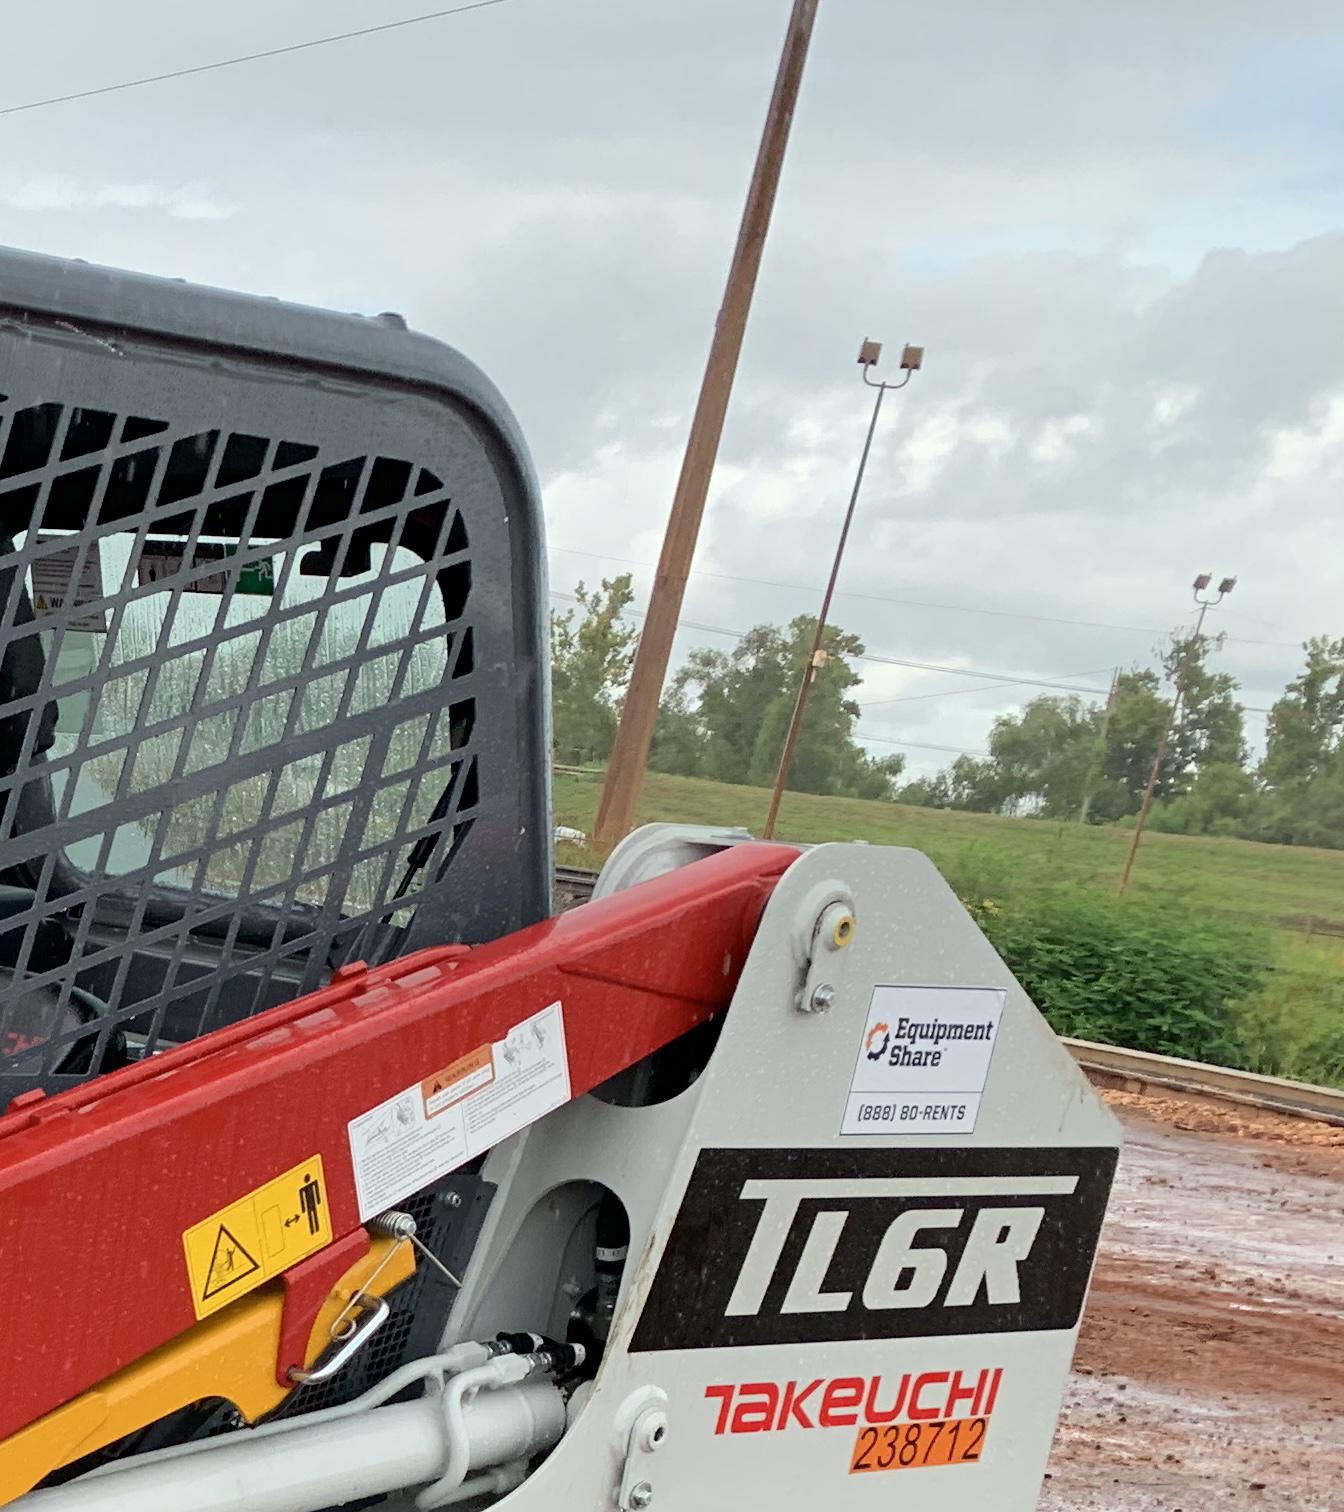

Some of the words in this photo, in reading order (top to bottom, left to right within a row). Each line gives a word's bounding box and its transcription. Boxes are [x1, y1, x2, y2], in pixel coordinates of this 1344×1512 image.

[895, 1017, 994, 1045] Equipment
[889, 1045, 942, 1067] Share
[858, 1104, 897, 1122] (888)
[724, 1175, 1080, 1316] TL6R
[704, 1368, 1003, 1435] TAKEUCHI
[853, 1418, 987, 1470] 238712
